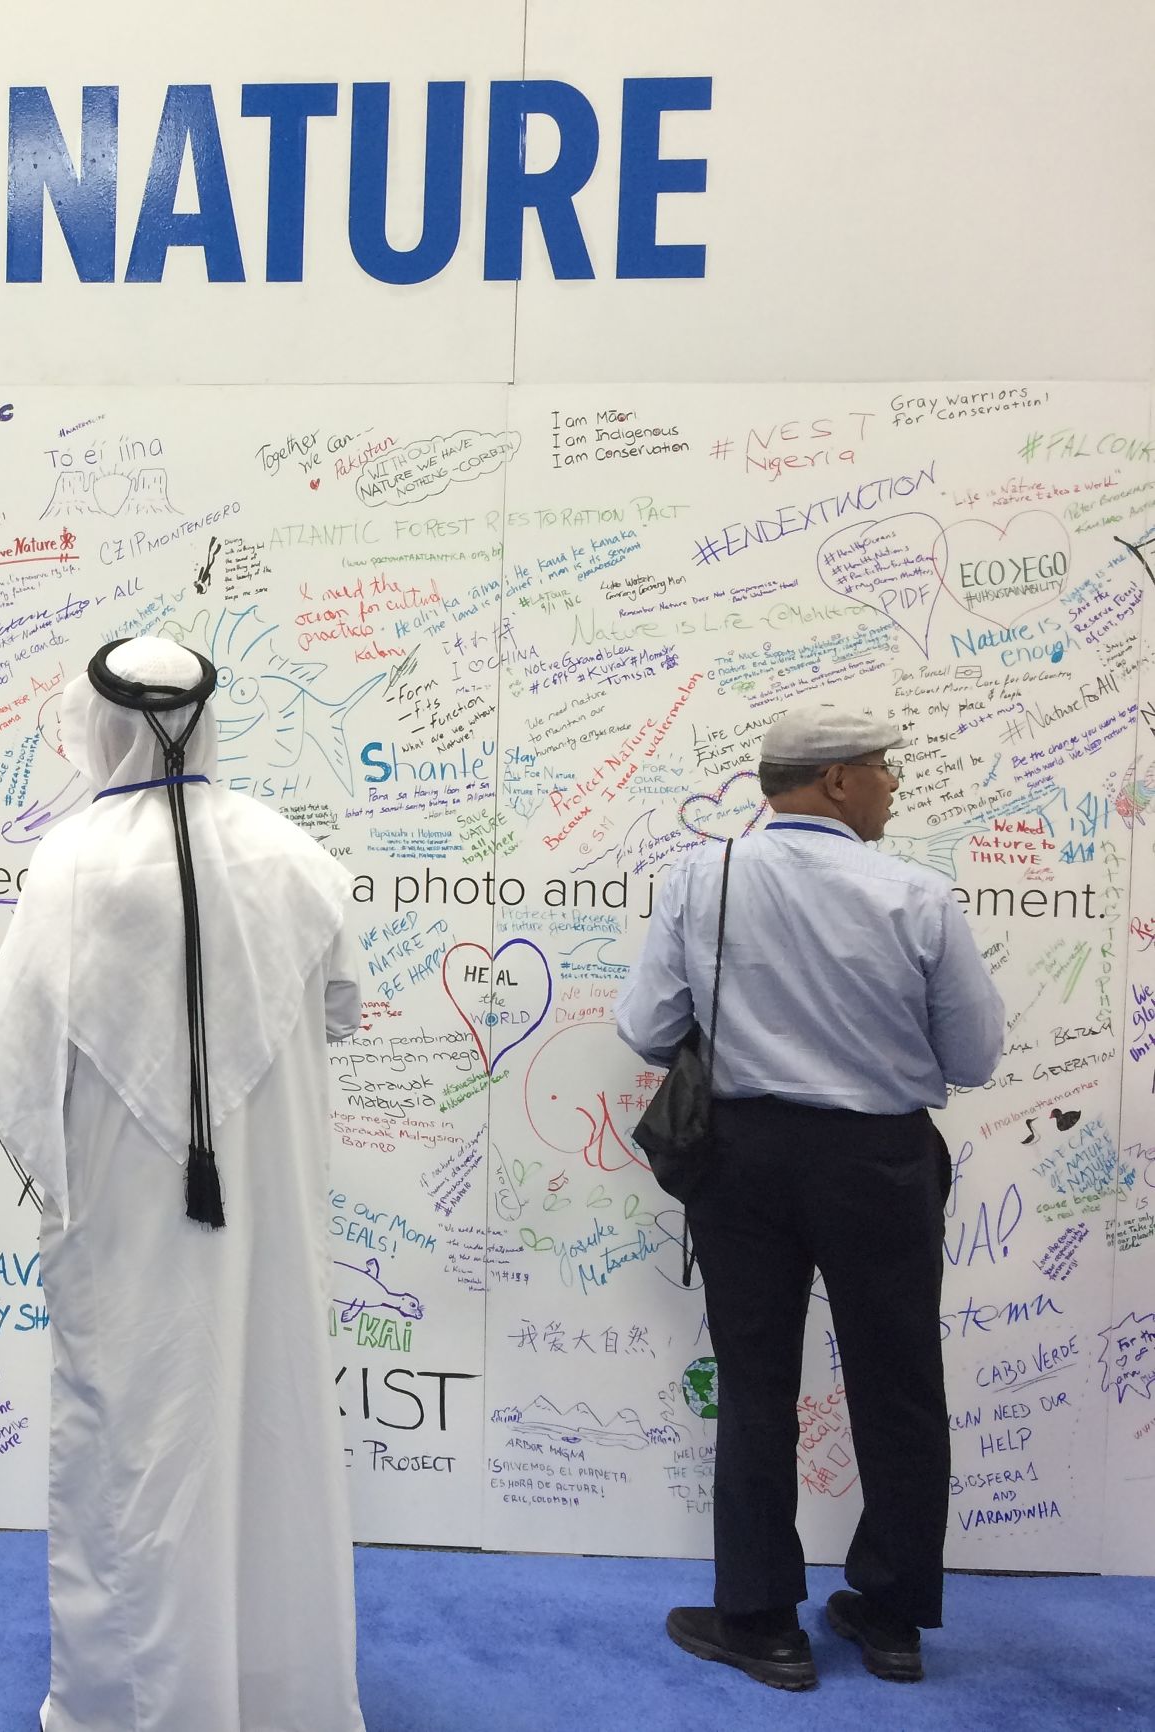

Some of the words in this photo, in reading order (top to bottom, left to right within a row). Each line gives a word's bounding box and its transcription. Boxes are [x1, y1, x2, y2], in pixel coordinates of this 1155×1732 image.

[891, 392, 938, 412] Gray
[565, 416, 587, 427] am
[892, 412, 924, 428] for
[567, 435, 588, 446] am
[596, 426, 680, 446] Indigenous
[256, 430, 320, 476] Together
[367, 441, 440, 480] WITHOUT
[568, 452, 589, 465] am
[595, 440, 690, 460] Conservation
[360, 467, 413, 499] NATURE
[441, 438, 473, 459] HAVE
[396, 468, 449, 497] NOTHING
[268, 520, 380, 549] ATLANTIC
[395, 518, 476, 538] FOREST
[486, 508, 625, 530] RESTORATION
[632, 497, 692, 527] PACT
[692, 460, 936, 567] #ENDEXTINCTION
[15, 537, 57, 555] Nature
[880, 587, 932, 614] PIDF
[950, 624, 1034, 658] Nature
[1000, 633, 1081, 668] enough
[899, 778, 950, 801] EXTINCT
[1016, 818, 1045, 835] Need
[970, 835, 1038, 850] Nature
[971, 851, 1042, 864] THRIVE
[353, 874, 375, 903] a
[395, 867, 525, 912] photo
[546, 872, 628, 909] and
[951, 884, 1106, 919] ement.
[358, 930, 380, 951] WE
[382, 911, 418, 939] NEED
[368, 936, 425, 976] NATURE
[378, 980, 405, 1000] BE
[464, 965, 518, 986] HEAL
[479, 992, 506, 1007] the
[1033, 1048, 1115, 1080] GENERATION
[391, 1215, 437, 1253] Monk
[508, 1319, 656, 1358] 我爱大自然
[976, 1358, 1027, 1388] CABO
[1033, 1335, 1079, 1372] VERDE
[993, 1404, 1031, 1421] NEED
[1040, 1391, 1071, 1412] OUR
[506, 1437, 544, 1453] ARBOR
[549, 1444, 585, 1461] MAGNA
[980, 1427, 1032, 1458] HELP
[992, 1491, 1017, 1501] AND
